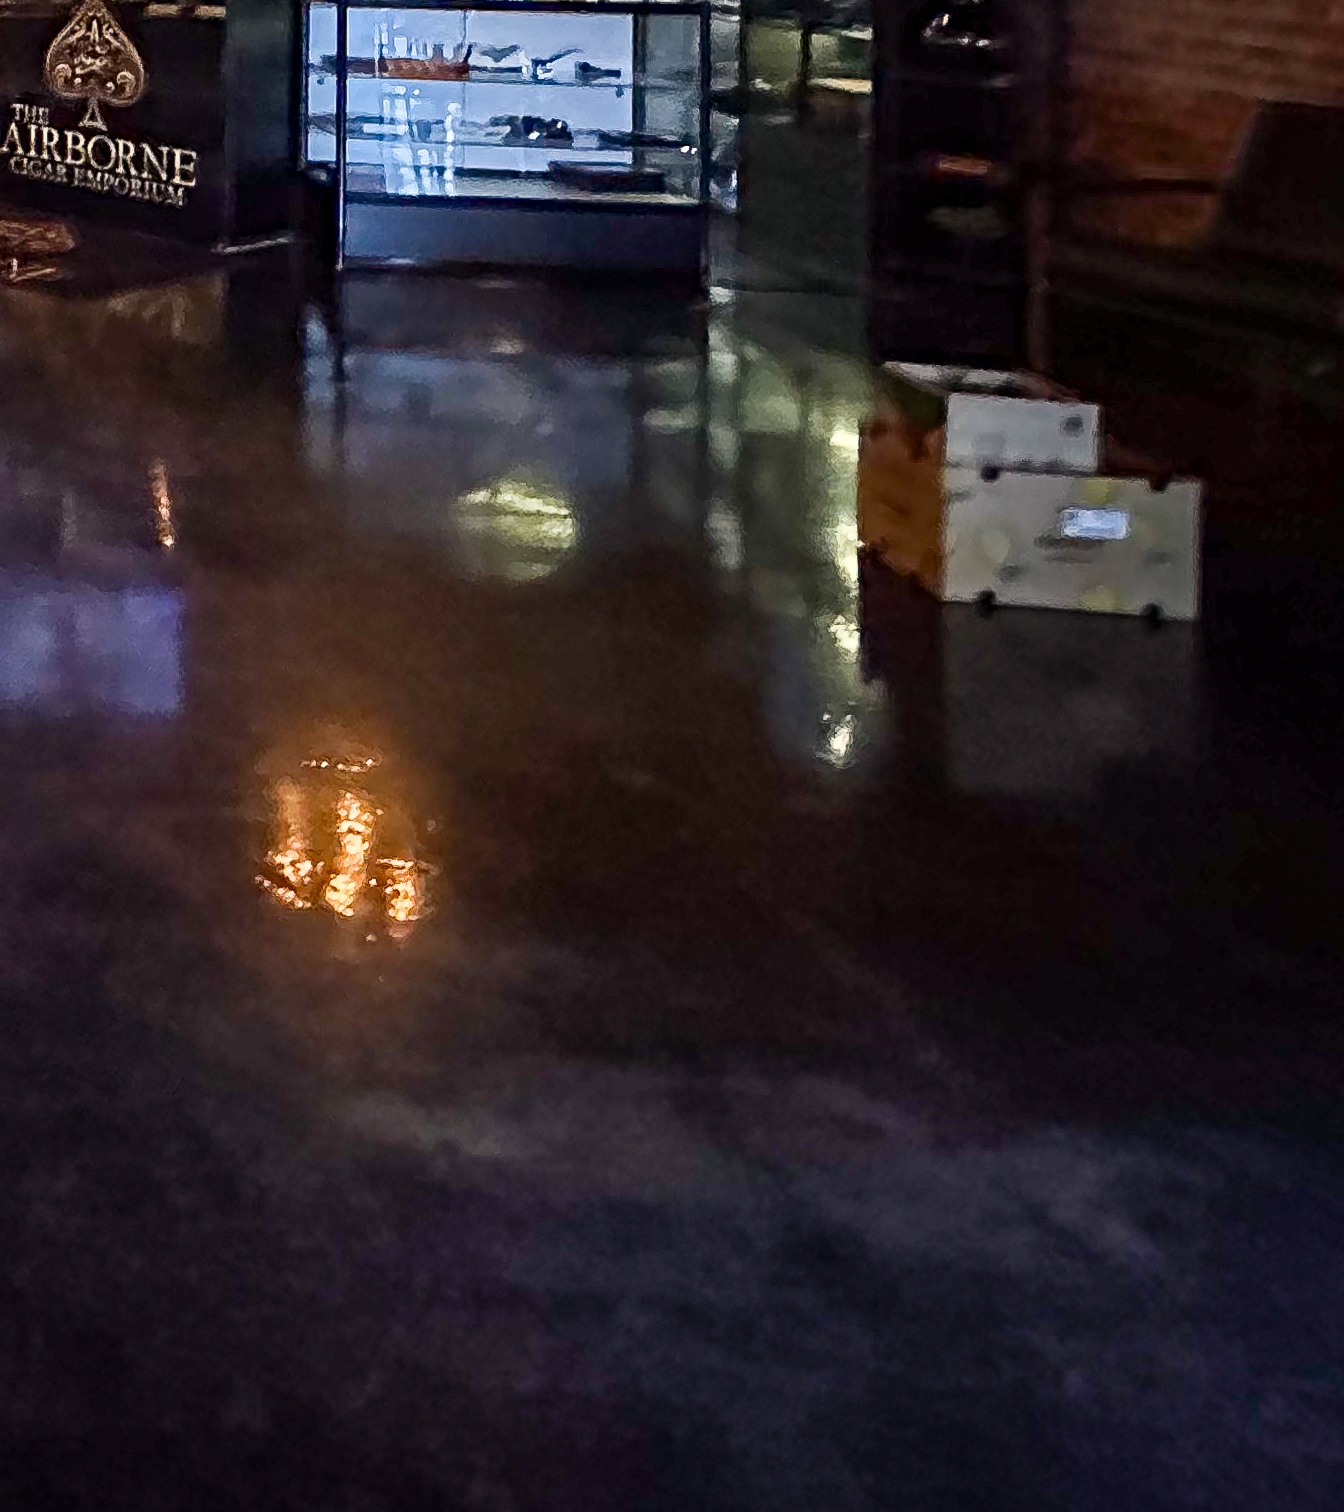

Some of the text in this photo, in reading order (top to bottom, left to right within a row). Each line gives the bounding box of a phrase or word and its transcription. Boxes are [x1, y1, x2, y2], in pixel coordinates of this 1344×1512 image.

[10, 103, 50, 126] THE
[8, 156, 188, 208] CIGAR EMPORIUM
